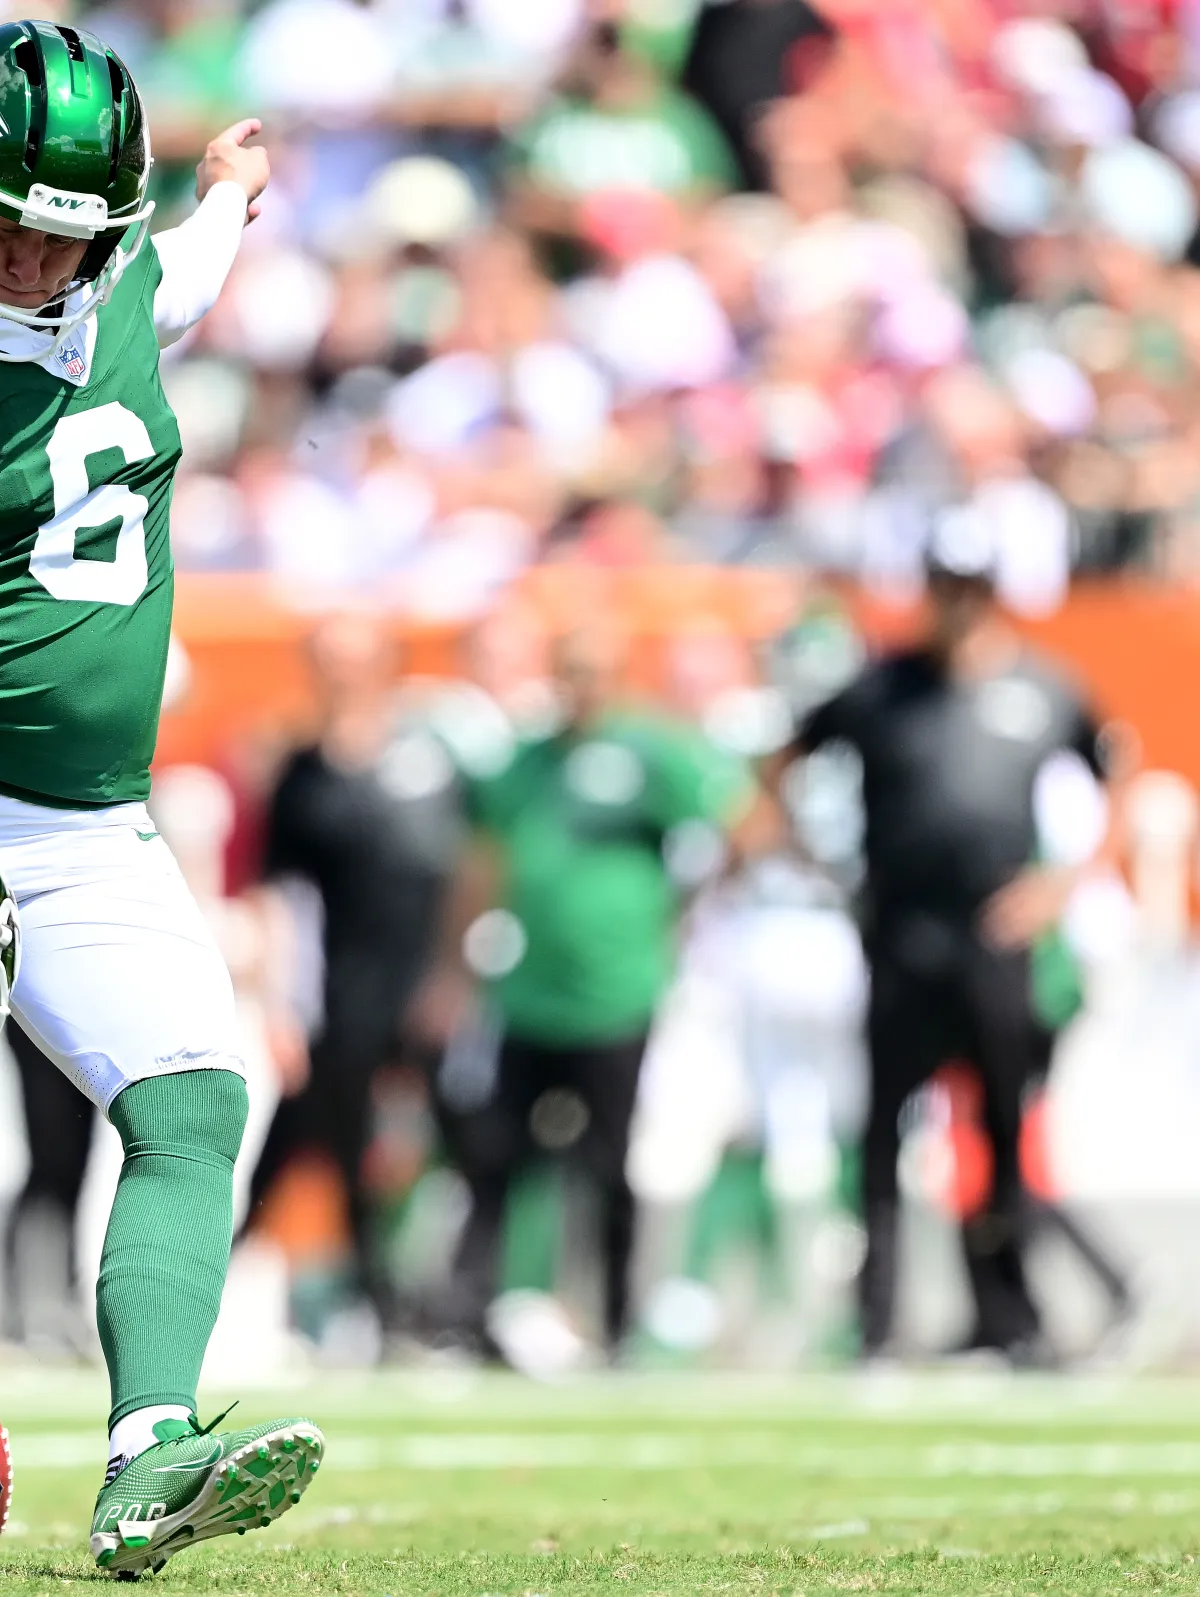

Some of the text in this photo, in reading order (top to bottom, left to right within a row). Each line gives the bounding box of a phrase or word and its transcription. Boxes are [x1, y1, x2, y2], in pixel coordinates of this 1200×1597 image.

[47, 196, 86, 210] NY
[66, 359, 84, 375] NFL
[29, 401, 156, 606] 6
